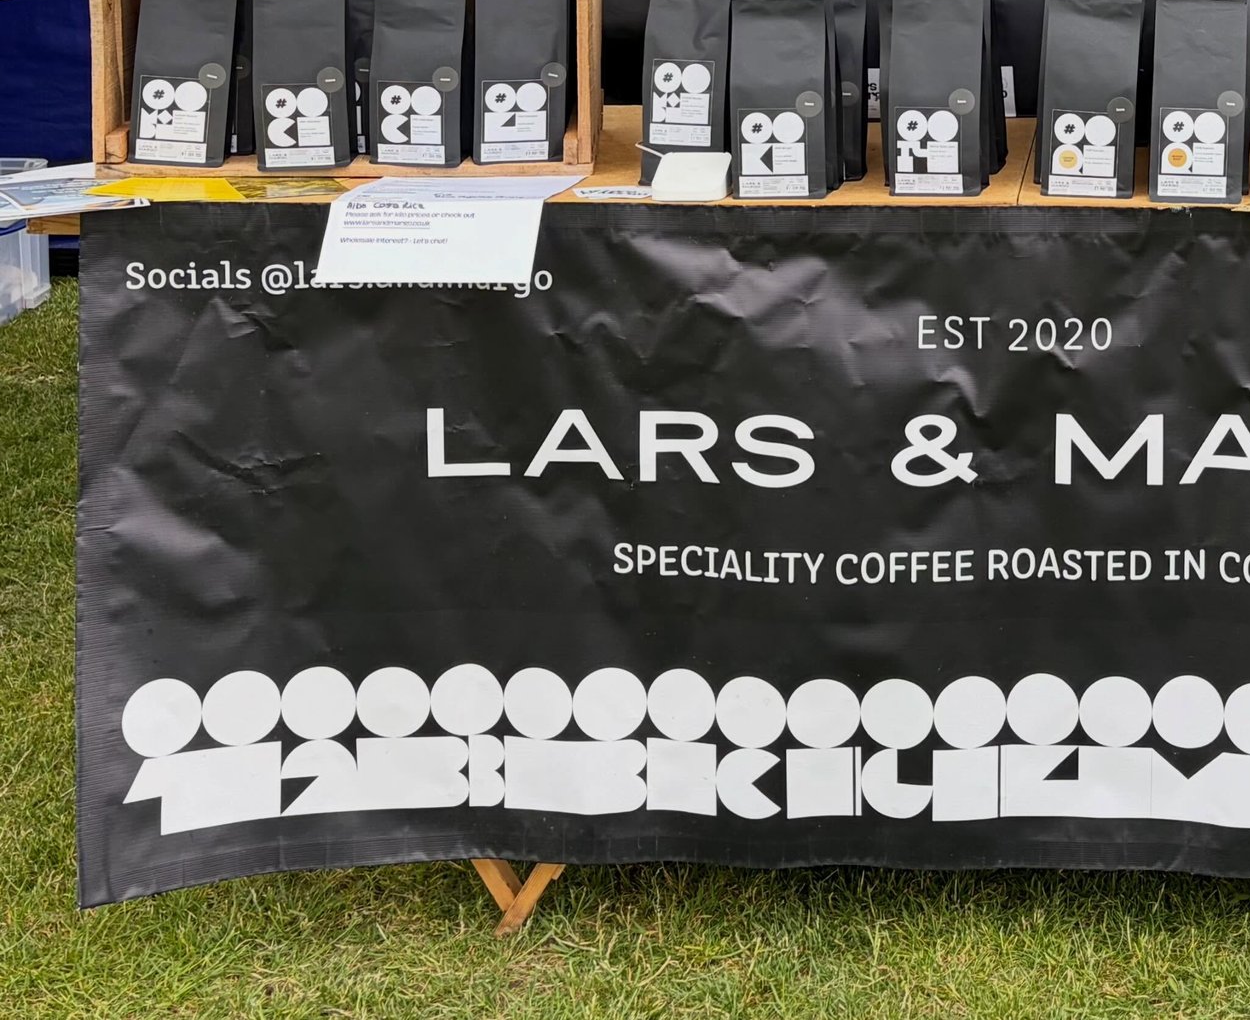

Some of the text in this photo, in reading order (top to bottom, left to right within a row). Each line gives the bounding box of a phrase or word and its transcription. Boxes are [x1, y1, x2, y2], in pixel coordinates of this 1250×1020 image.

[126, 260, 251, 290] Socials
[918, 316, 1113, 352] EST 2020
[426, 407, 816, 489] LARS
[889, 413, 978, 488] &
[613, 543, 824, 584] SPECIALITY
[835, 550, 975, 586] COFFEE
[987, 548, 1152, 582] ROASTED
[1163, 549, 1206, 581] IN
